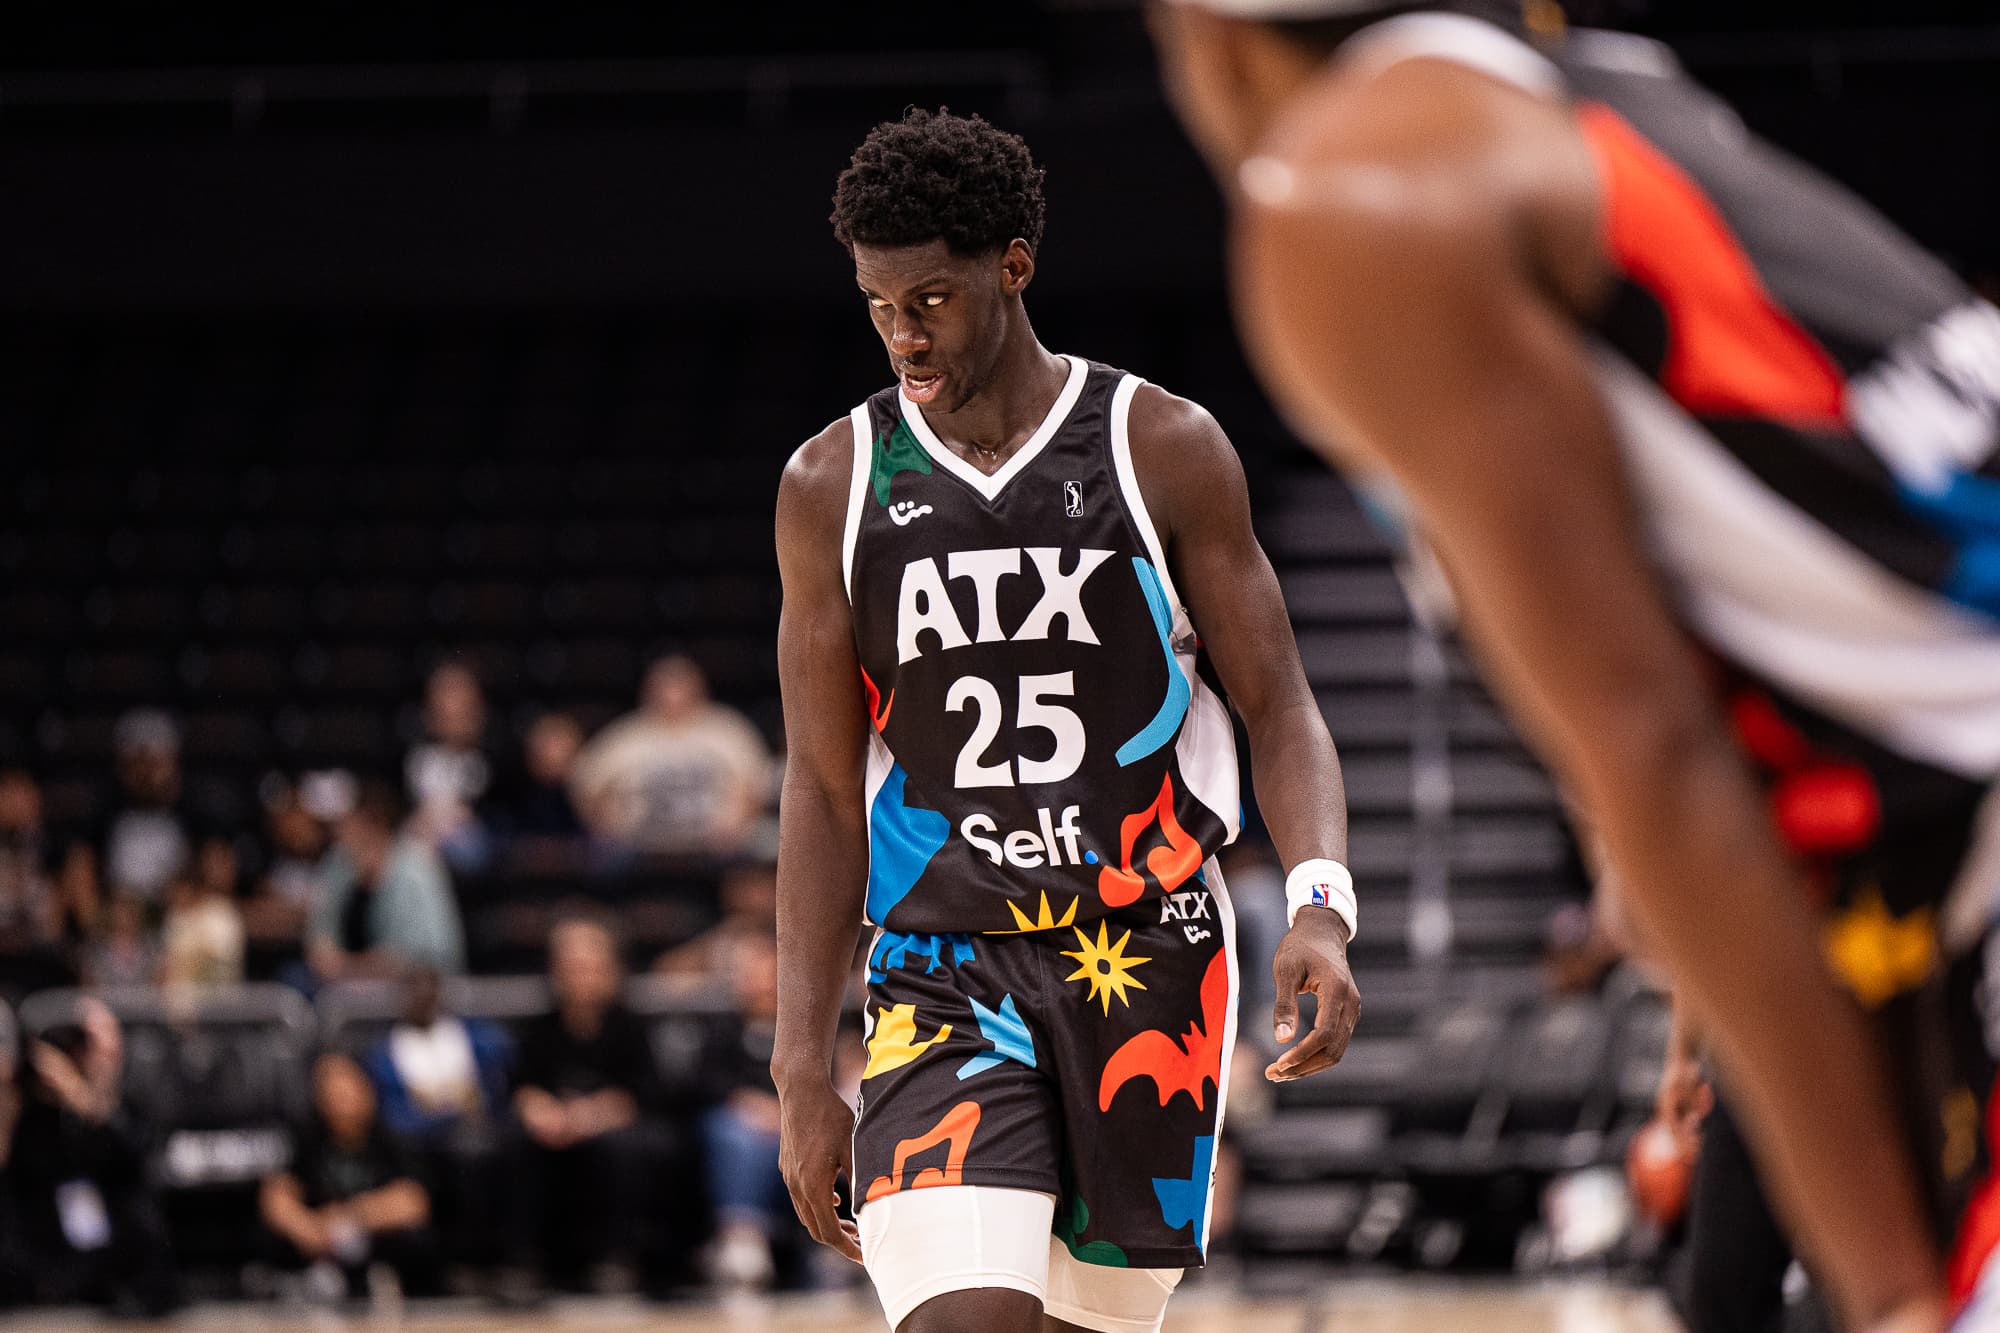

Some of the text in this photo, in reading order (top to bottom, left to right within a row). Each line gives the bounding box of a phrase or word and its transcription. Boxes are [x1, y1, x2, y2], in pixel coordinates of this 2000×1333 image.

[897, 547, 1117, 666] ATX
[945, 670, 1086, 789] 25
[1160, 891, 1211, 924] ATX
